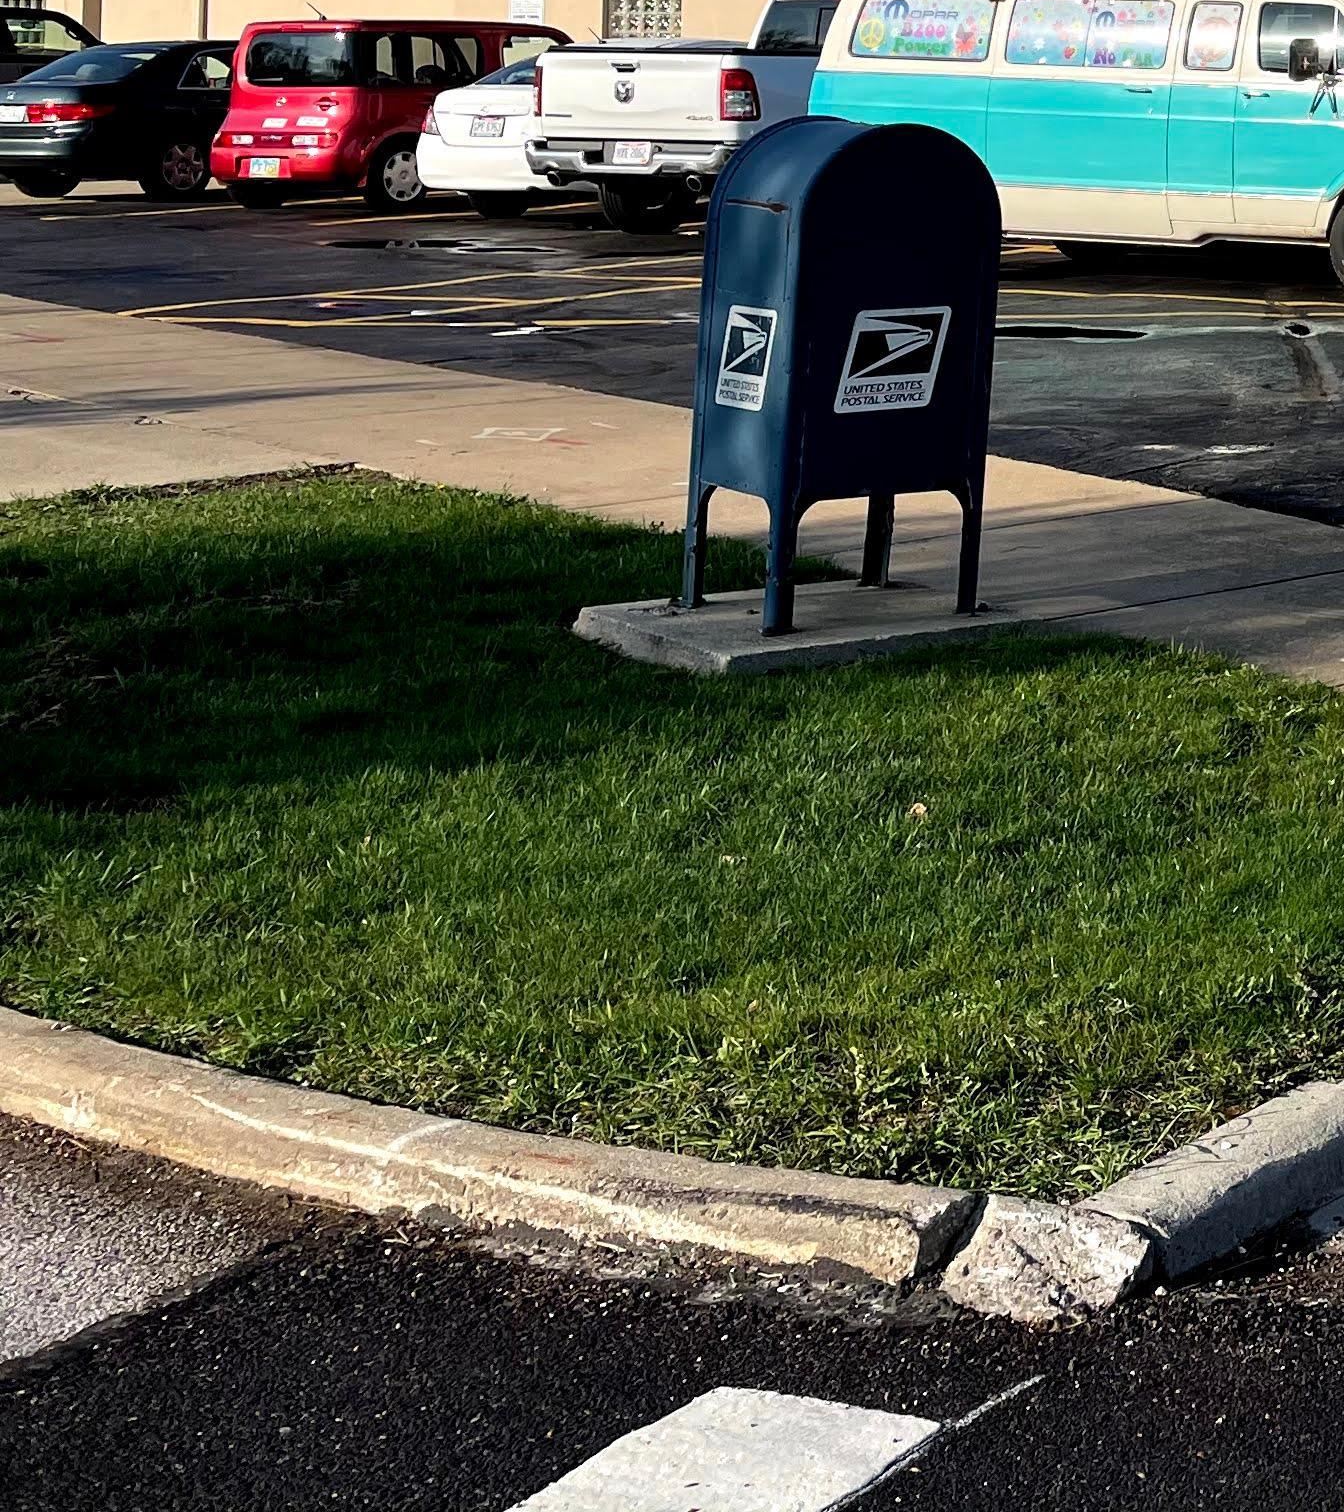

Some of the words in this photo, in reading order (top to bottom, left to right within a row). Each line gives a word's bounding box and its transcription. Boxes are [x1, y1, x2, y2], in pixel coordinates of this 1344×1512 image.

[844, 383, 885, 395] UNITED
[886, 380, 923, 391] STATES
[841, 396, 881, 407] POSTAL
[883, 392, 925, 404] SERVICE
